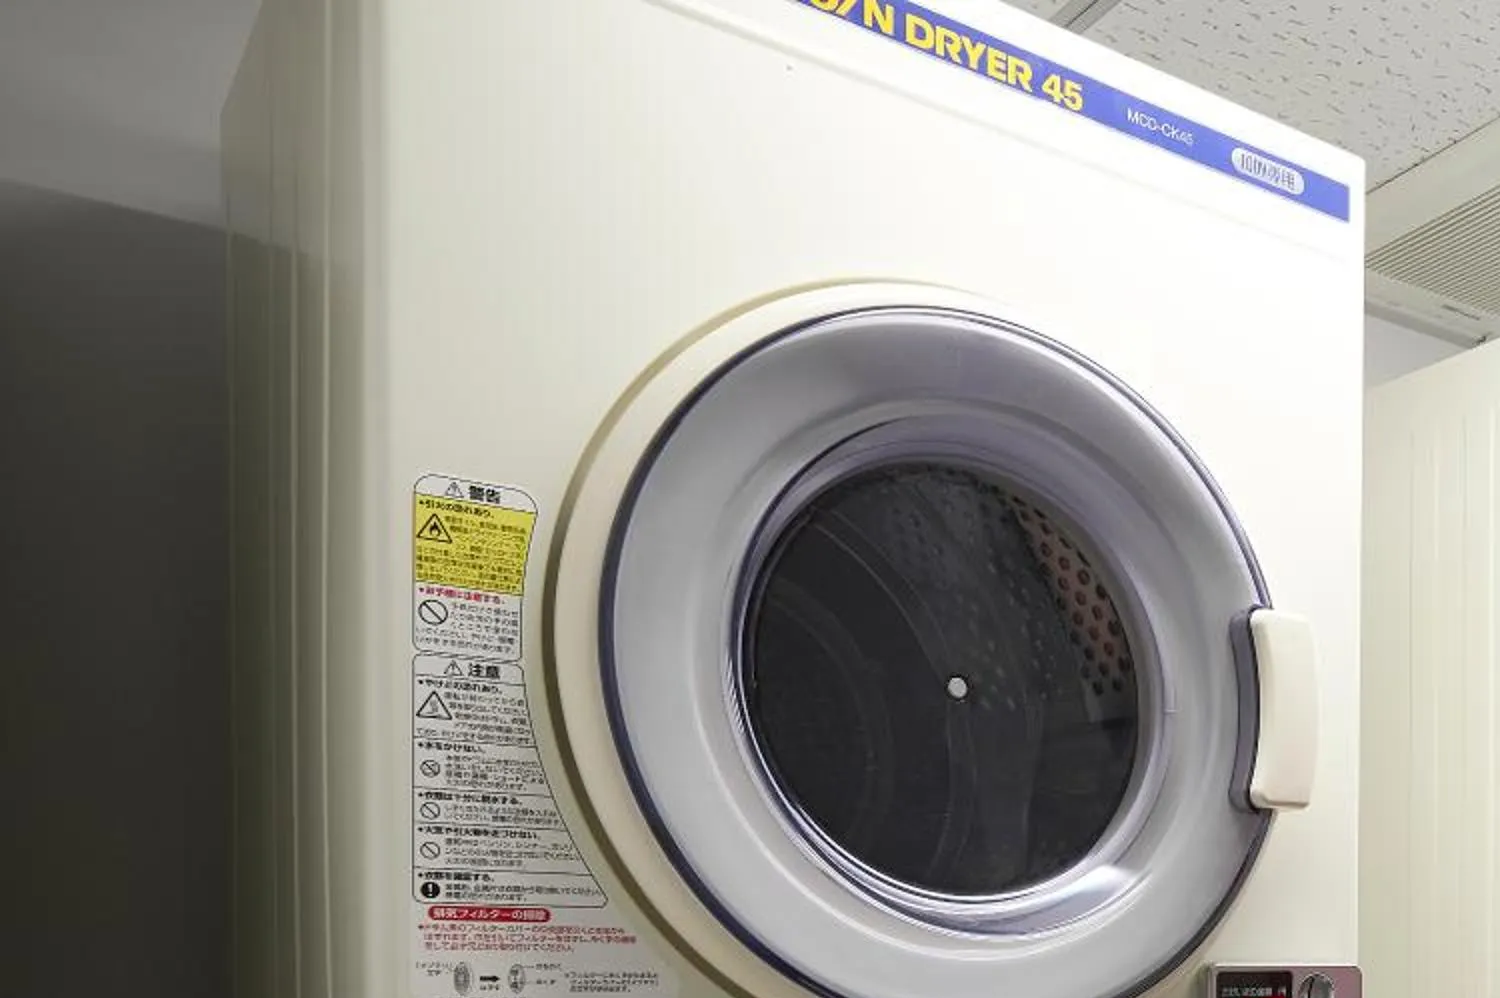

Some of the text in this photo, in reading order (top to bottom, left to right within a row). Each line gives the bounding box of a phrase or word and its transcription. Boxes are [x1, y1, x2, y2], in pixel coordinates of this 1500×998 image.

[905, 13, 1032, 92] DRYER
[1041, 73, 1083, 111] 45
[468, 663, 500, 679] 注意
